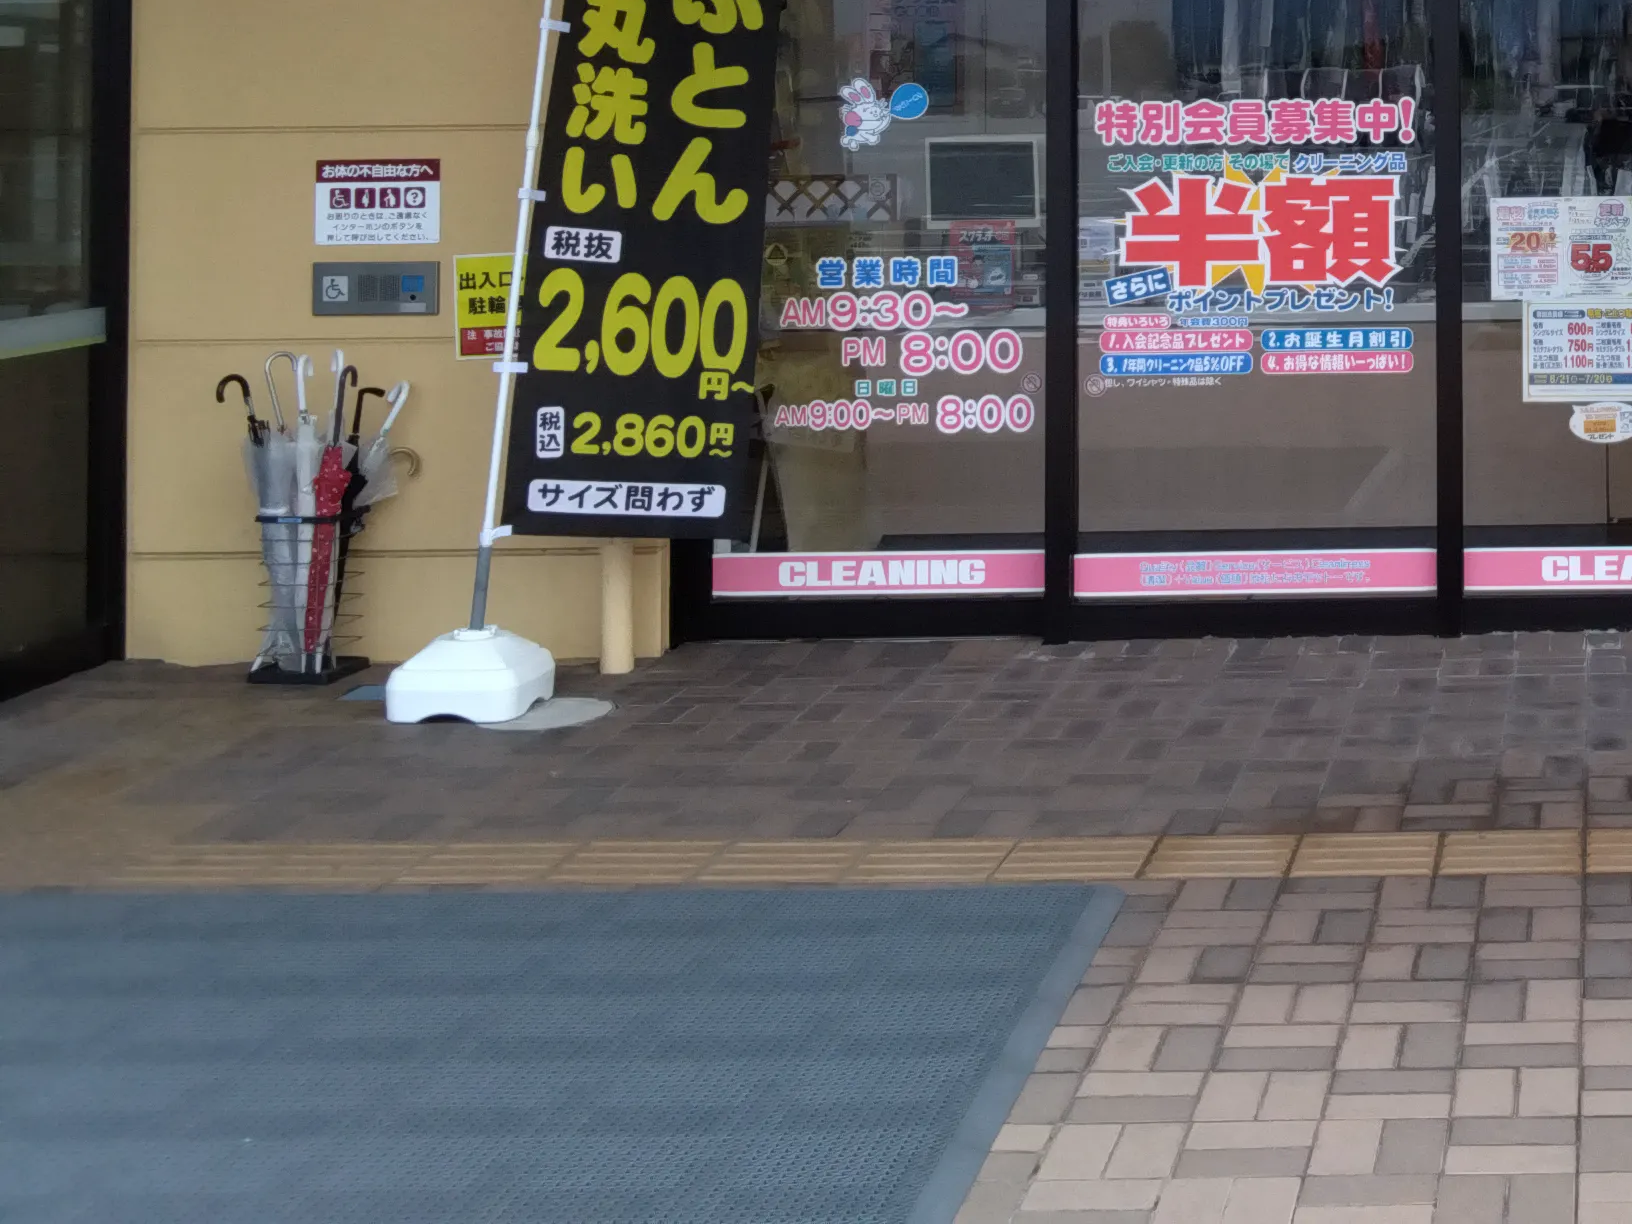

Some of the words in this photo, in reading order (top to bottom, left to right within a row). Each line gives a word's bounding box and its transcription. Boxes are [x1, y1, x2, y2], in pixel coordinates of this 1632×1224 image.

[1096, 98, 1416, 146] 特別会員募集中!
[321, 164, 434, 179] お体の不自由な方へ
[1107, 154, 1223, 172] ご入会・更新の方
[1228, 153, 1289, 171] その場で
[1294, 152, 1407, 172] クリーニング品
[551, 230, 614, 260] 税抜
[1122, 177, 1400, 287] 半額
[817, 258, 957, 288] 営業時間
[1110, 273, 1167, 300] さらに
[1167, 288, 1395, 313] ポイントプレゼント!
[1107, 317, 1169, 327] 特典いろいろ
[1179, 317, 1249, 327] 年会費300円
[842, 336, 886, 367] PM
[1568, 339, 1594, 352] 750円
[855, 379, 918, 397] 日曜日
[538, 411, 561, 453] 税込
[538, 484, 715, 512] サイズ問わず
[778, 559, 985, 587] CLEANING
